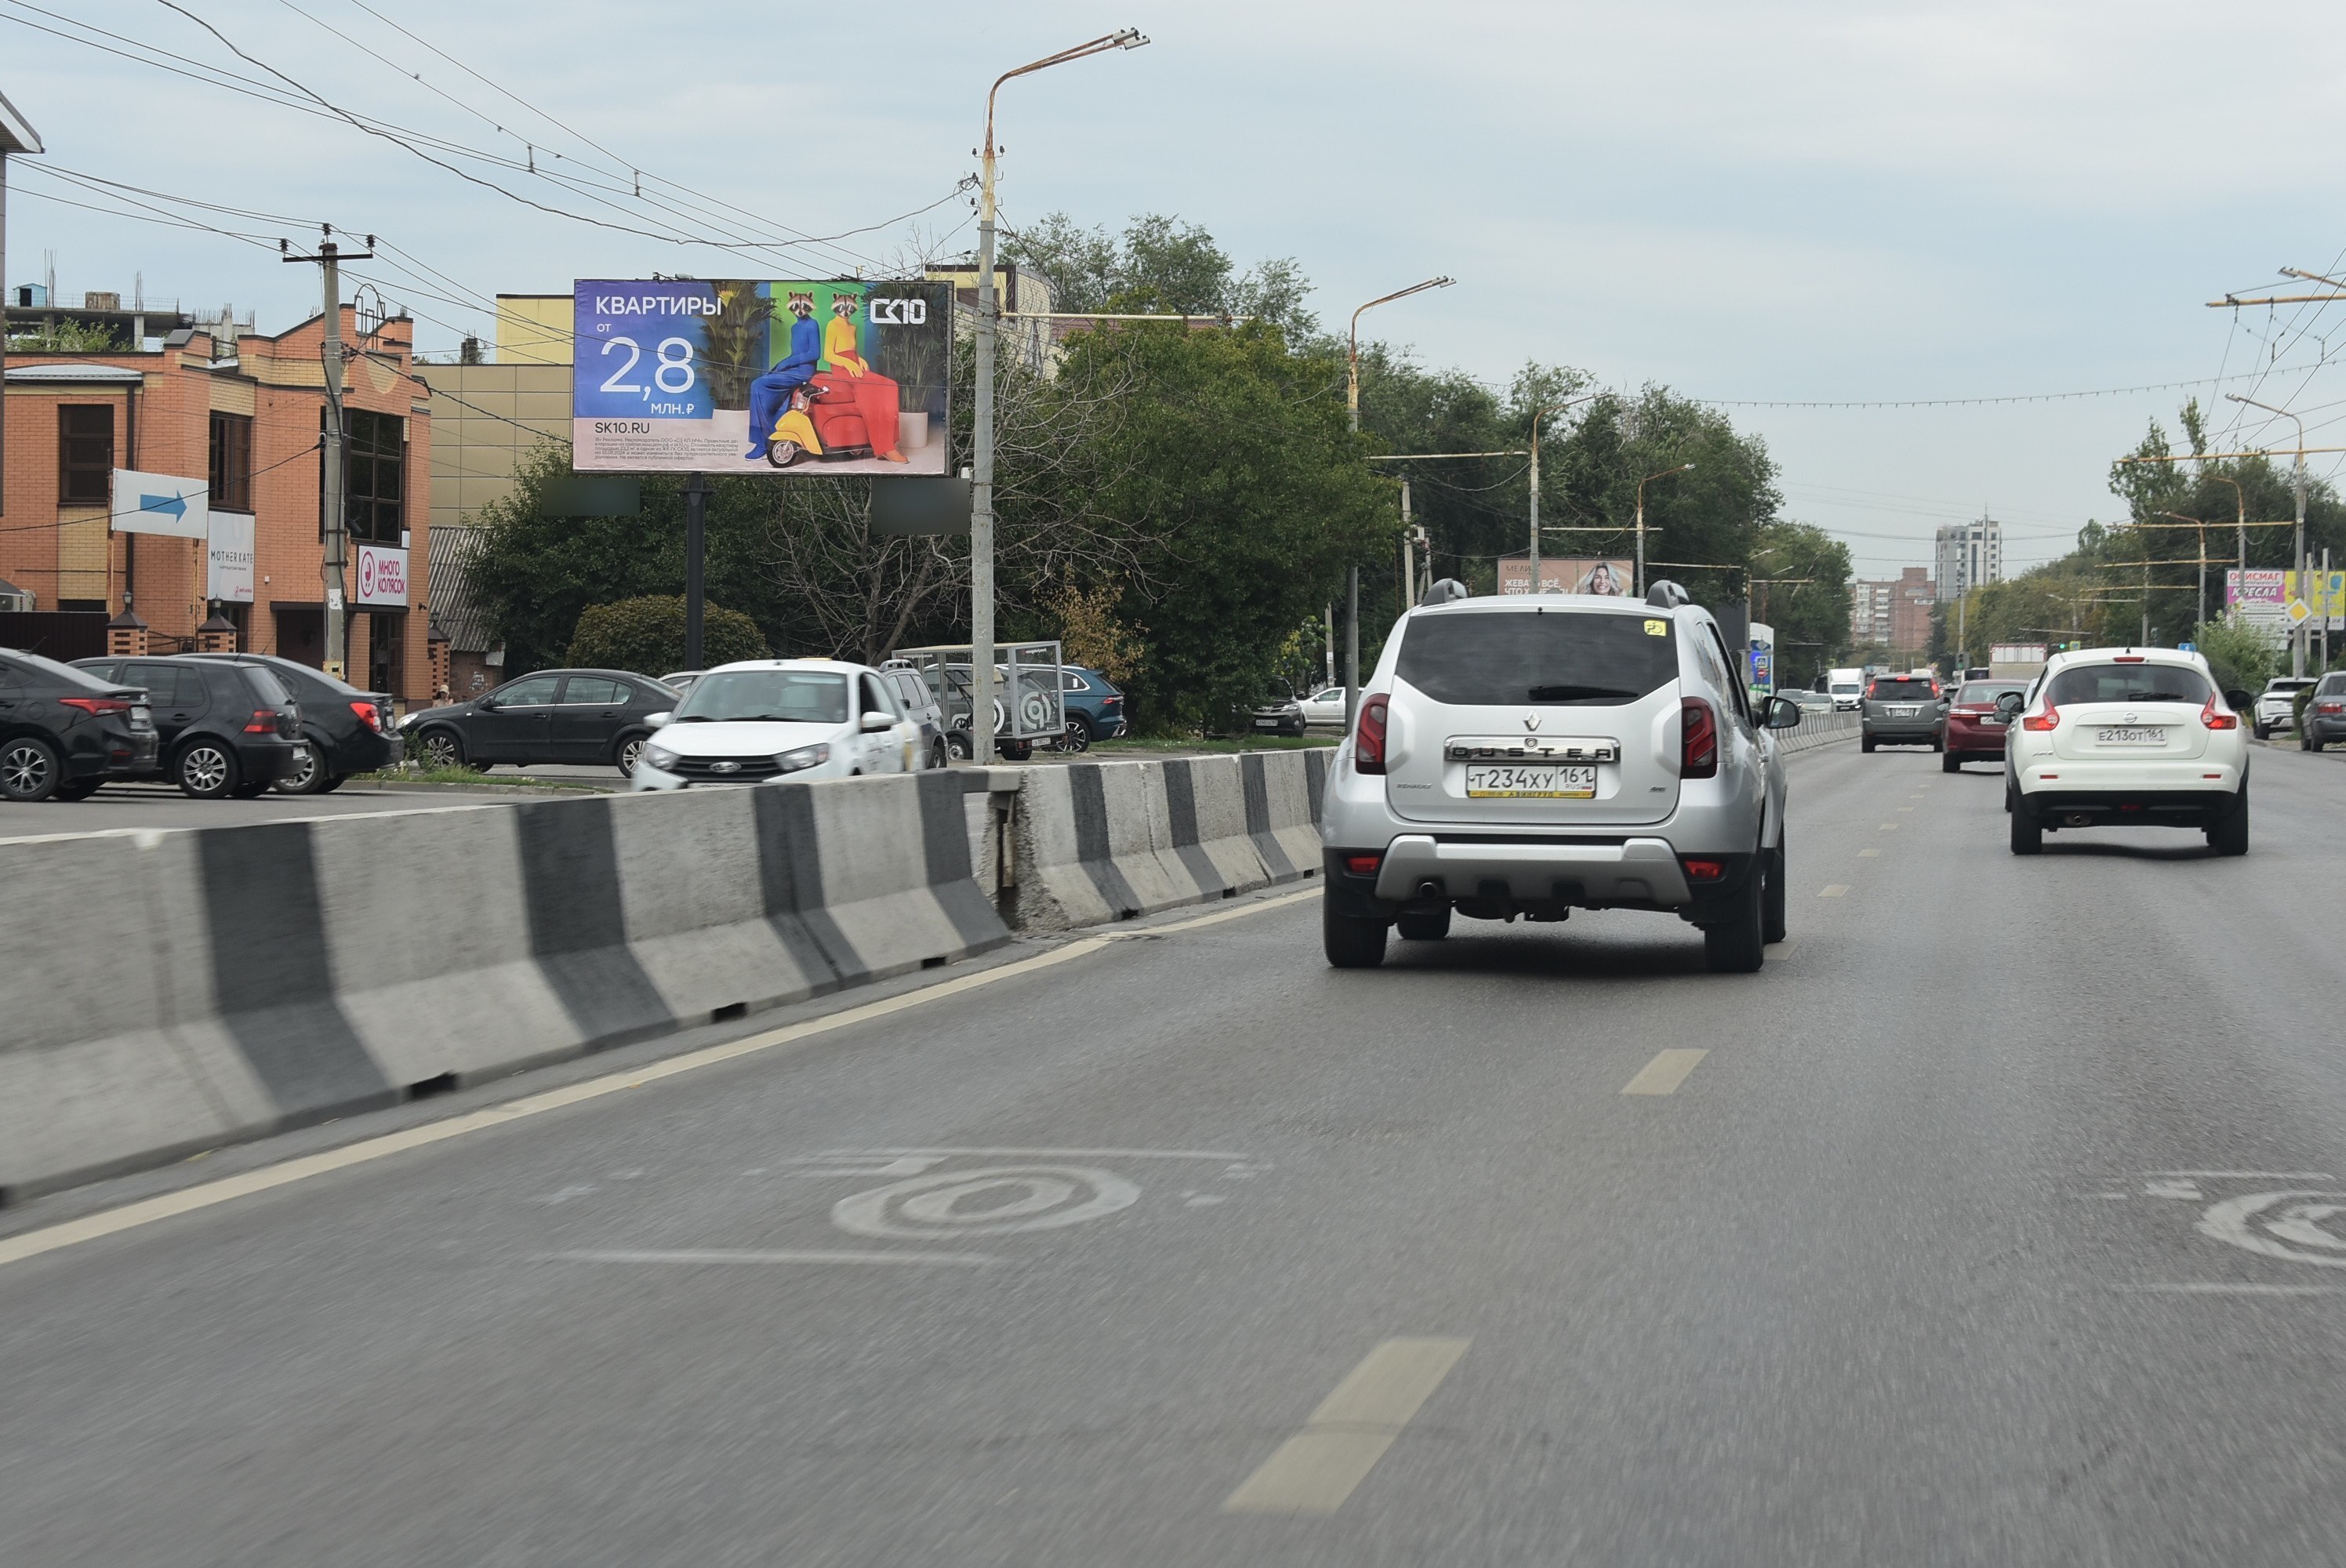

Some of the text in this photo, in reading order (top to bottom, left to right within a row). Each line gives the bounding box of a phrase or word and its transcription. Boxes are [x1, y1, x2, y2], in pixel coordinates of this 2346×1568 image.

[596, 296, 721, 315] КВАРТИРЫ
[600, 336, 695, 401] 2,8
[594, 422, 650, 434] SK10.RU
[211, 550, 253, 564] MOTHER KATE
[378, 559, 401, 576] МНОГО
[377, 577, 405, 594] КОЛЯСОК
[1505, 579, 1541, 587] ЖЕВА
[2098, 728, 2165, 742] Е213ОТ 161
[1452, 747, 1611, 759] DUSTER
[1476, 768, 1591, 789] Т234ХУ 161
